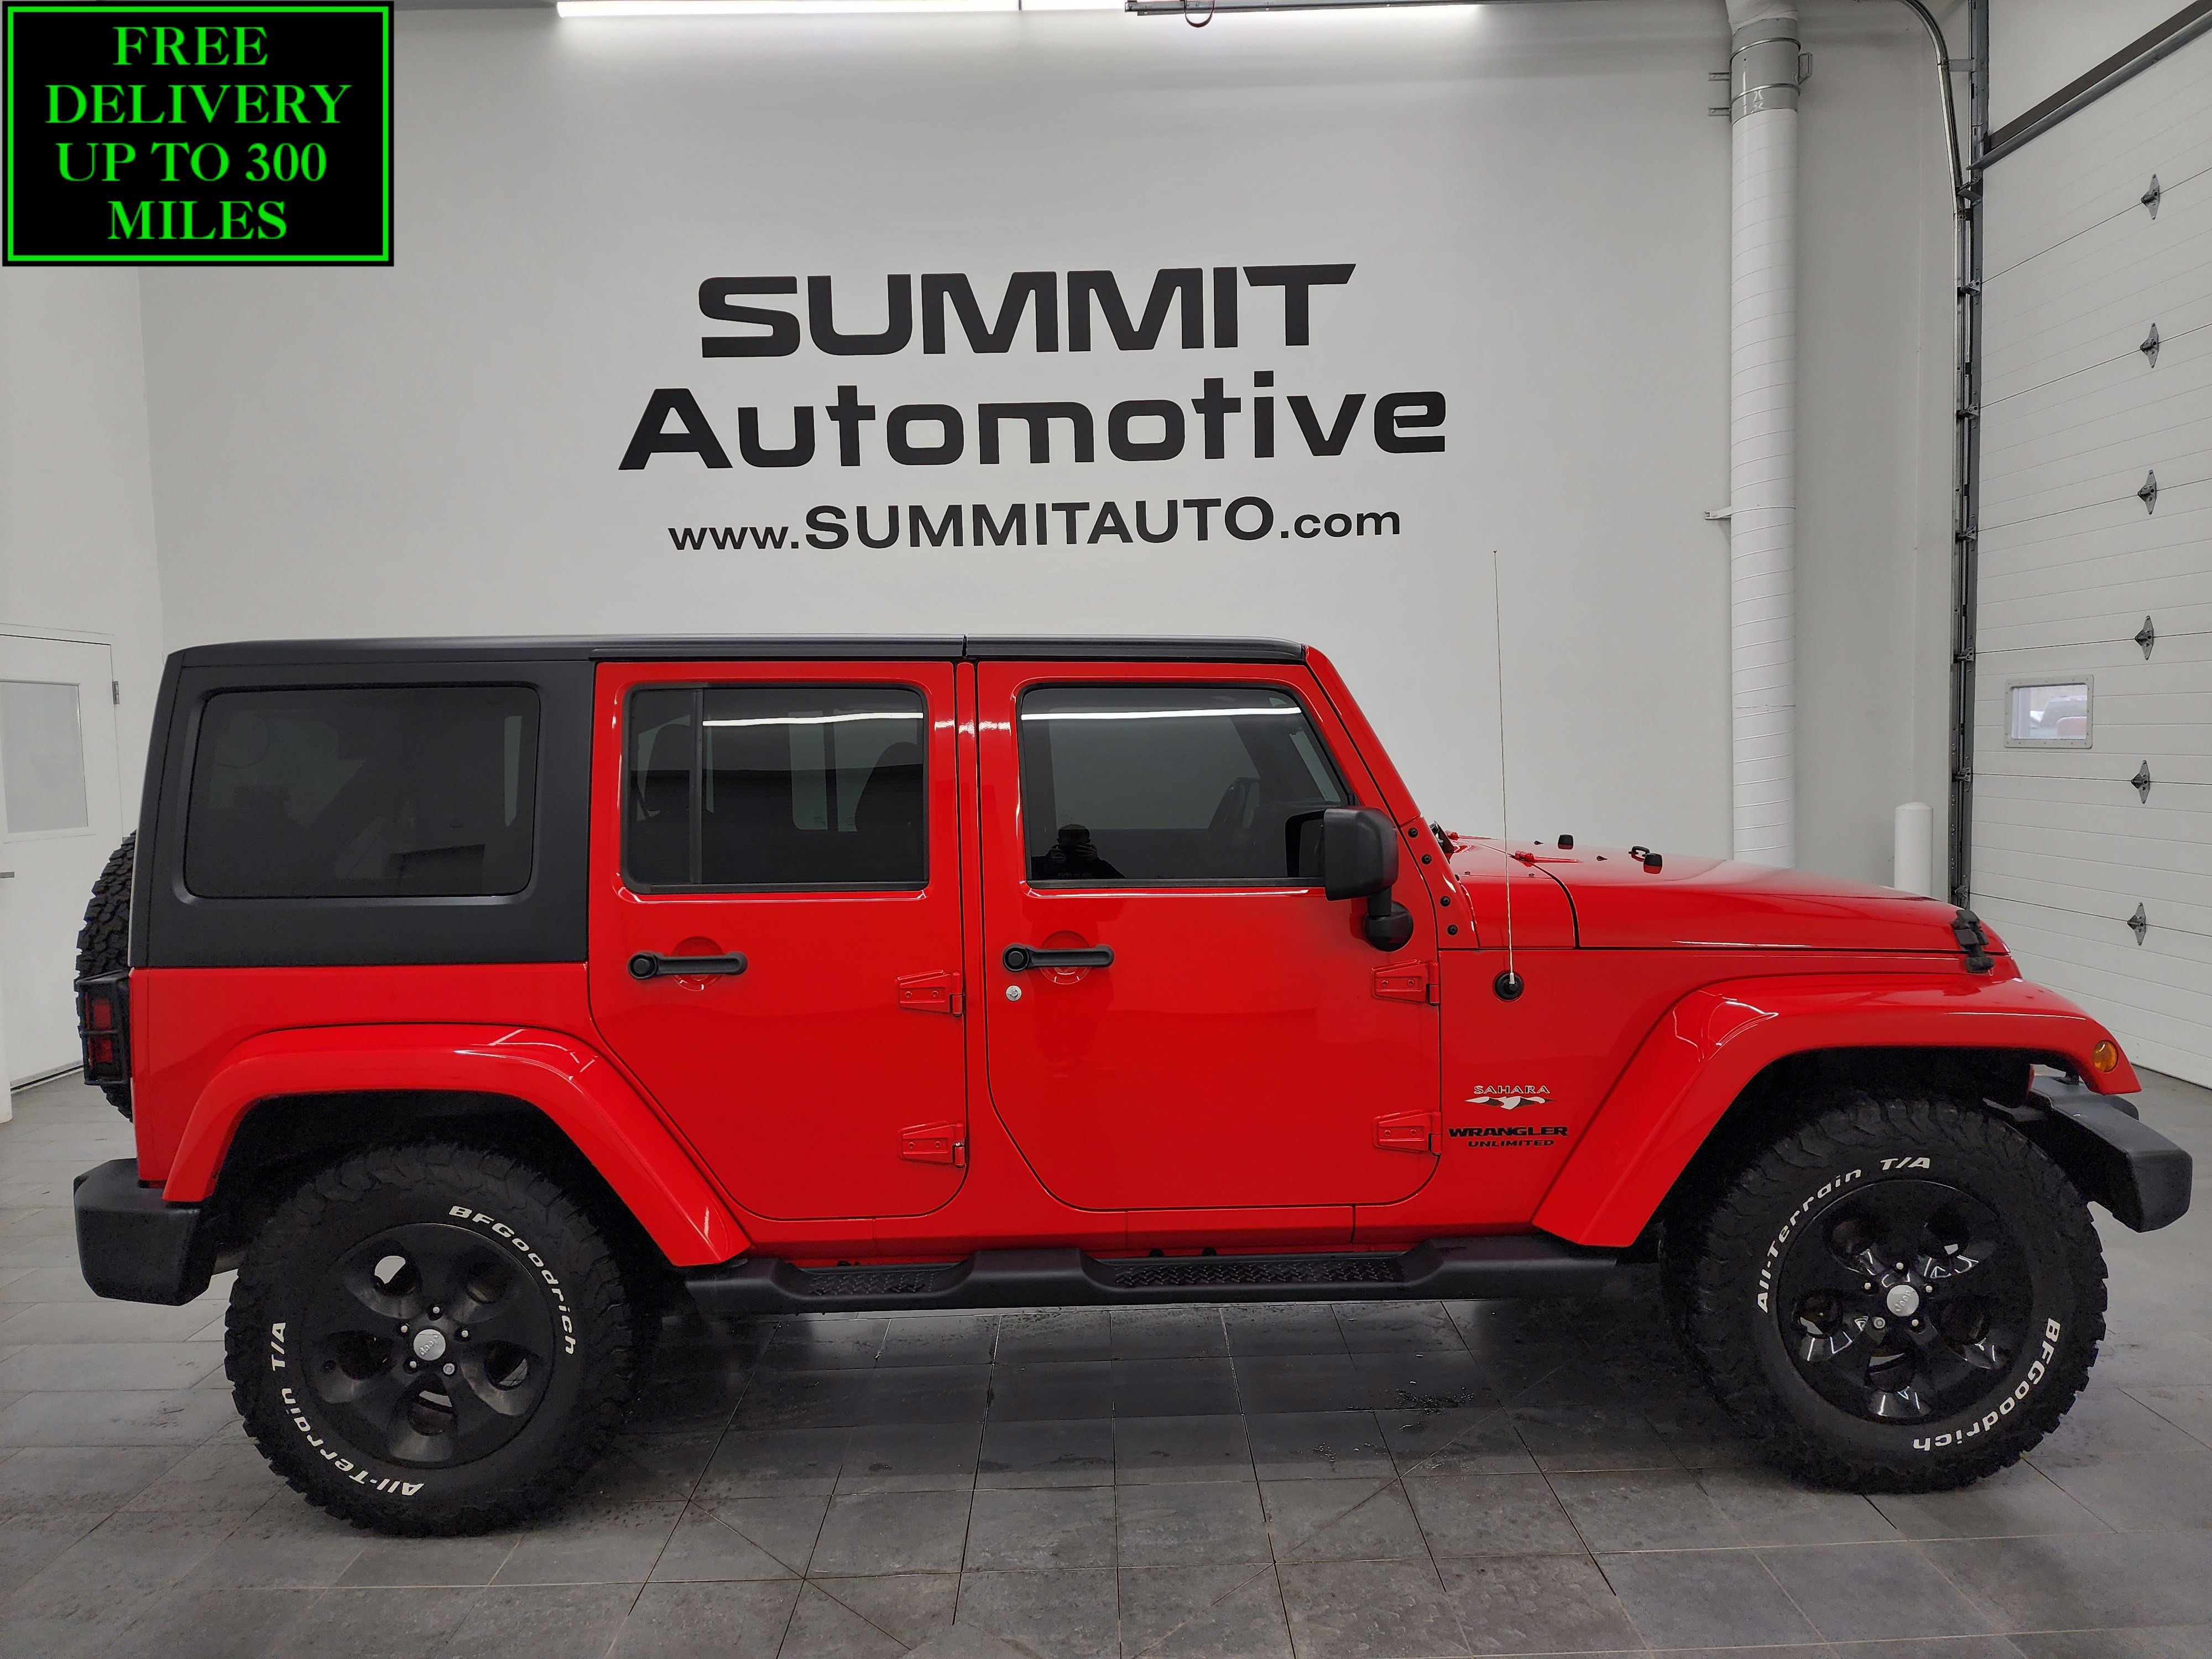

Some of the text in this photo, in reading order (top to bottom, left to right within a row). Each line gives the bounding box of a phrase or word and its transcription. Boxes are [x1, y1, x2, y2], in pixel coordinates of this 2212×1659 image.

[698, 263, 1357, 358] SUMMIT
[618, 370, 1446, 471] Automotive
[667, 496, 1400, 550] www.SUMMITAUTO.com
[1448, 1126, 1568, 1137] WRANGLER
[1473, 1085, 1551, 1094] SAHARA
[448, 1206, 576, 1354] BFGoodrich
[1757, 1157, 1931, 1313] All-Terrain T/A
[271, 1322, 425, 1496] All-Terrain T/A
[1913, 1318, 2060, 1451] BFGoodrich
